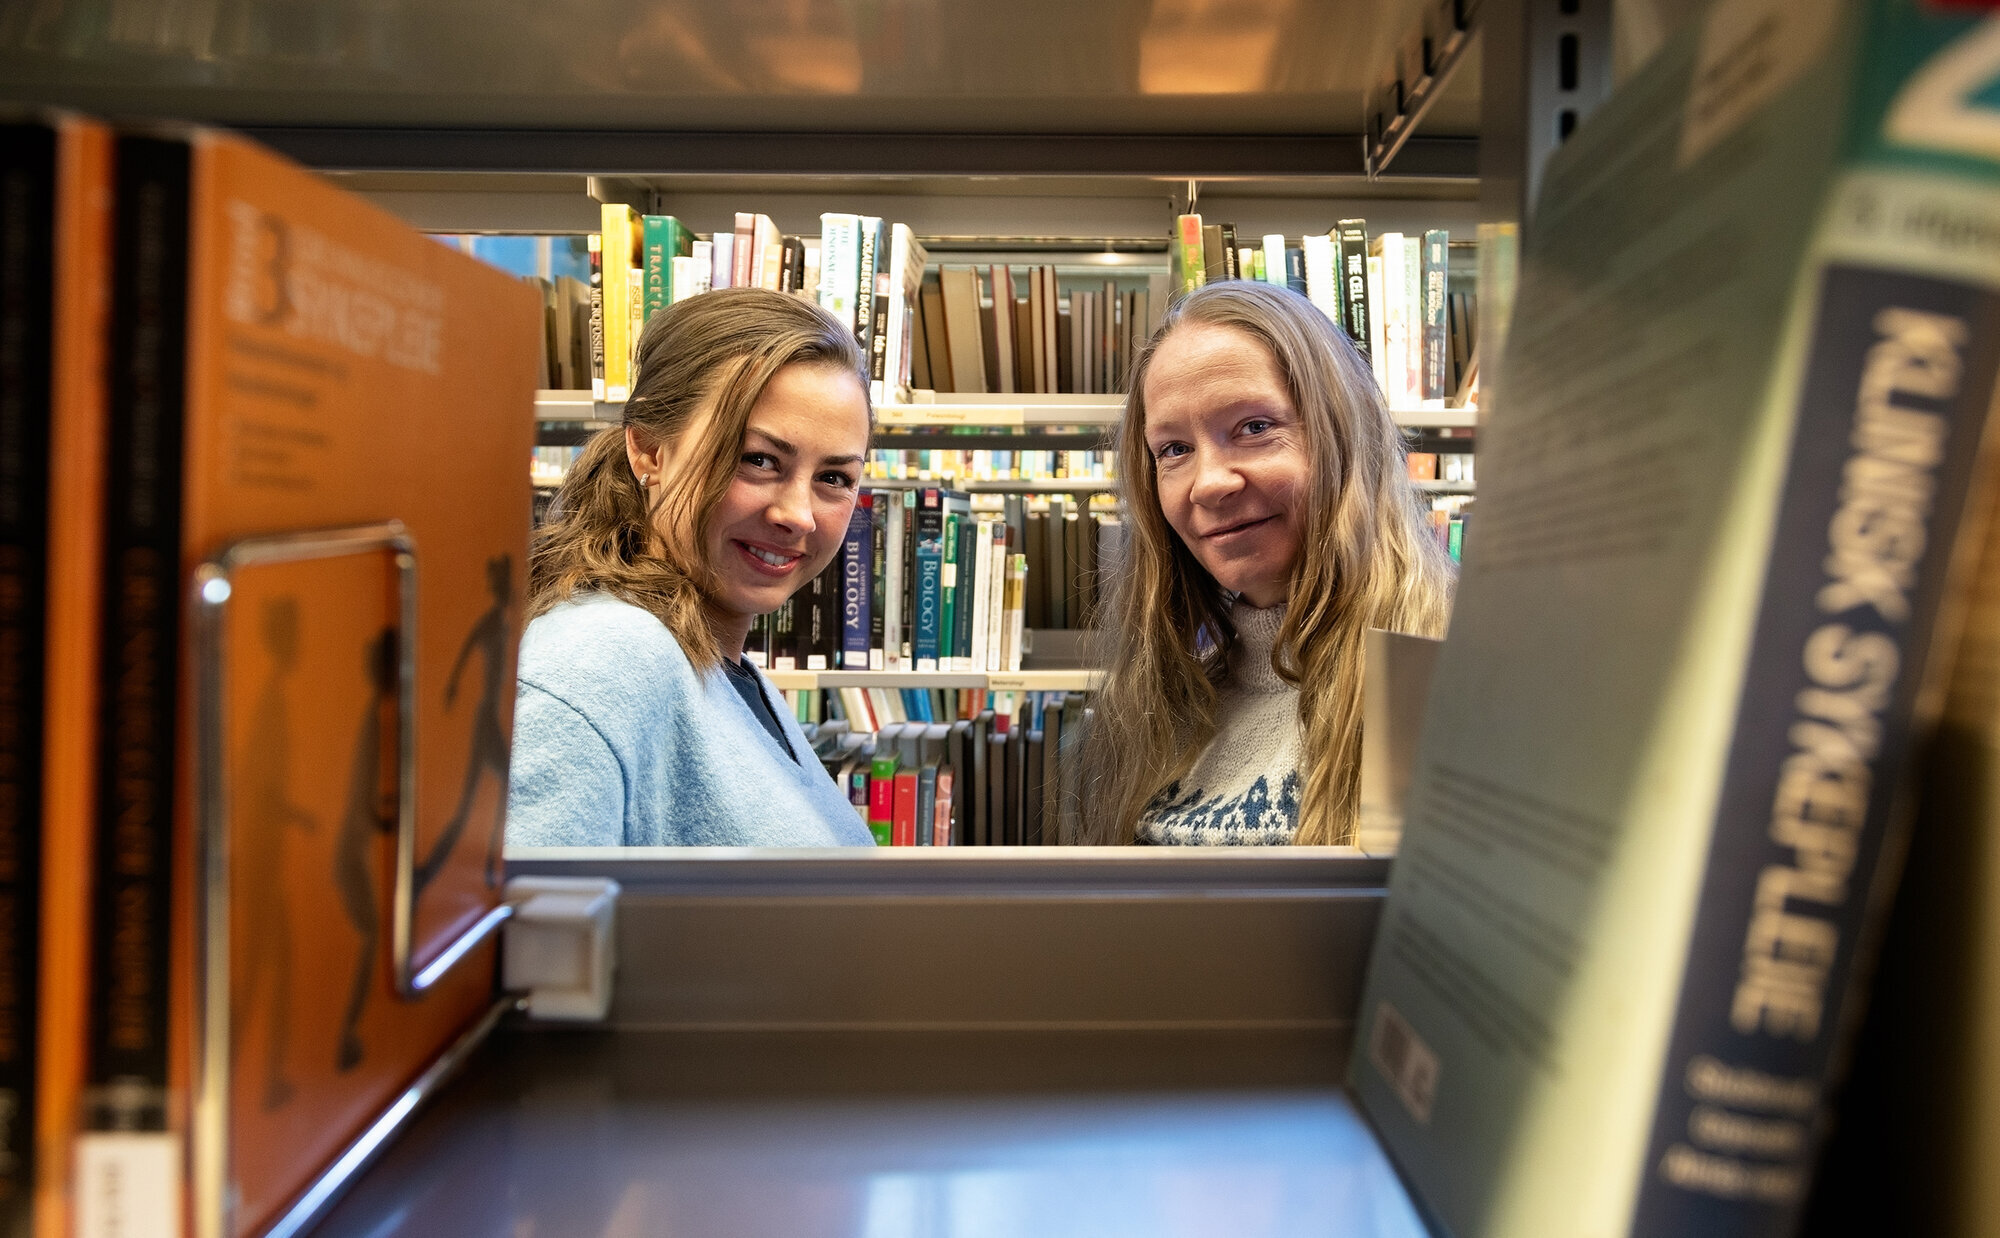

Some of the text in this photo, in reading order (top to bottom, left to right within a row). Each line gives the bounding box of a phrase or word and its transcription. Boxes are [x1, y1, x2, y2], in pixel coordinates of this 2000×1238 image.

[650, 244, 661, 293] TRACE
[1348, 253, 1363, 275] THE
[1349, 275, 1364, 302] CELL
[1428, 271, 1437, 291] CELL
[591, 287, 603, 363] MICROFOSSILS
[873, 334, 885, 353] Ida
[1813, 305, 1970, 622] KLINISK
[845, 540, 860, 631] BIOLOGY
[859, 563, 867, 607] CAMPBELL
[921, 560, 938, 634] BIOLOGY
[1729, 622, 1903, 1042] SYKEPLEIE
